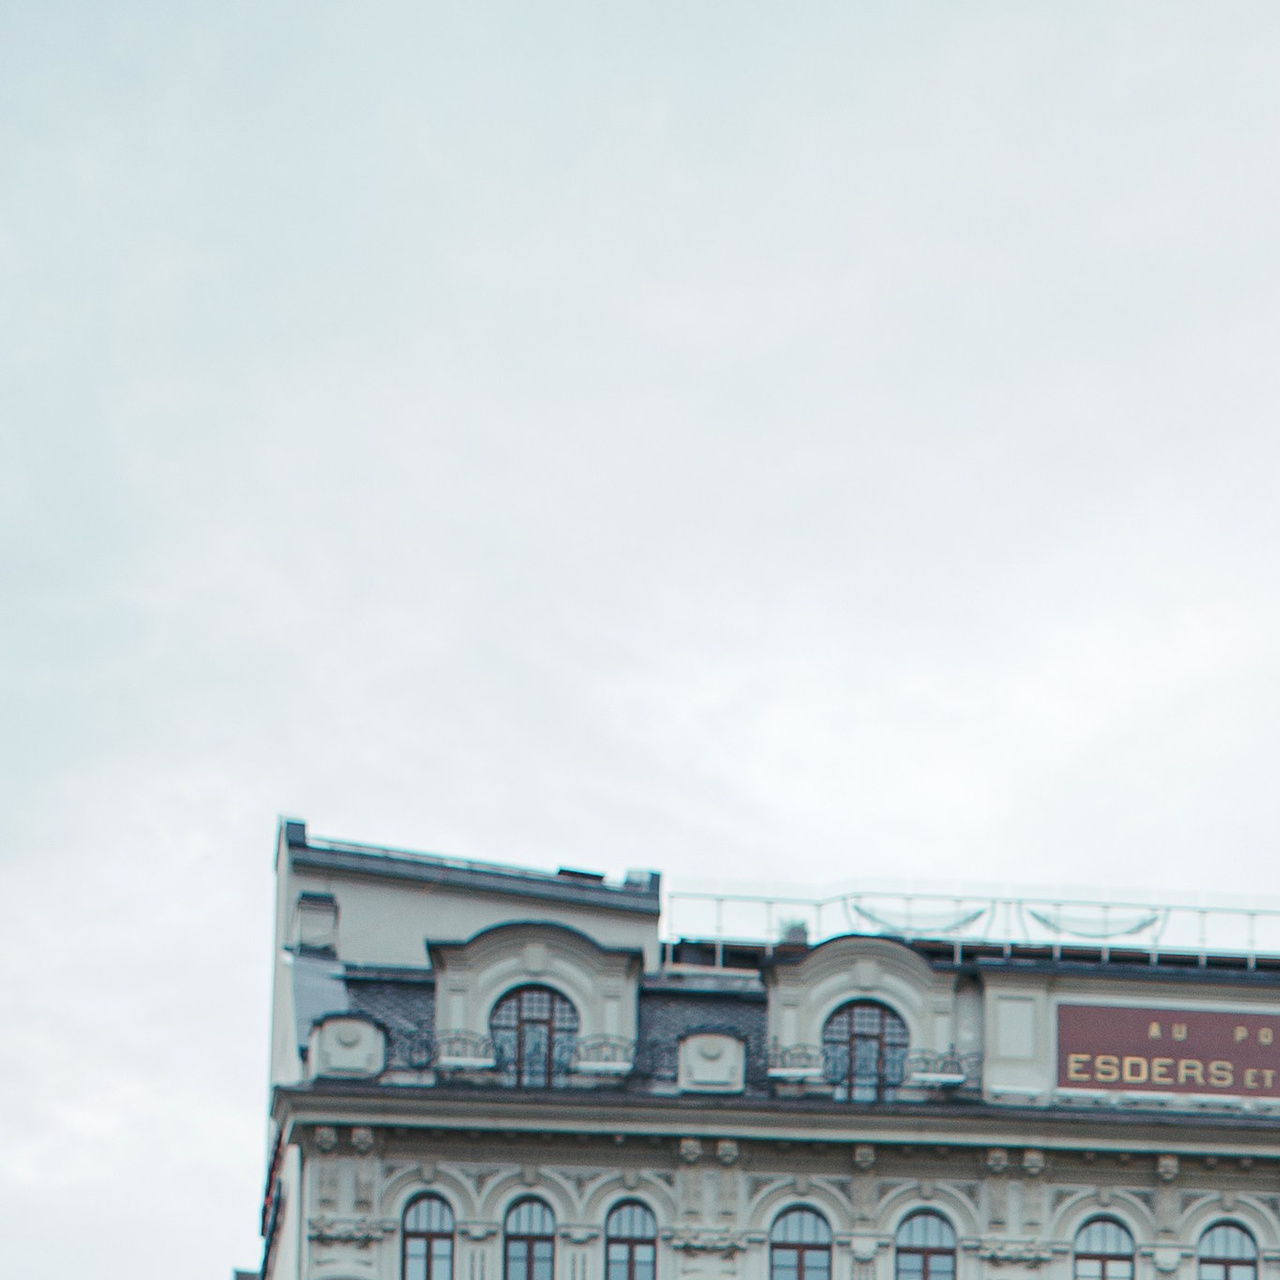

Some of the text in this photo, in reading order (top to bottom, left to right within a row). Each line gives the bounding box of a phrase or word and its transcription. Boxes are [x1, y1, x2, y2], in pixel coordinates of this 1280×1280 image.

[1149, 1022, 1186, 1041] AU
[1067, 1053, 1233, 1088] ESDERS
[1245, 1069, 1275, 1088] ET
